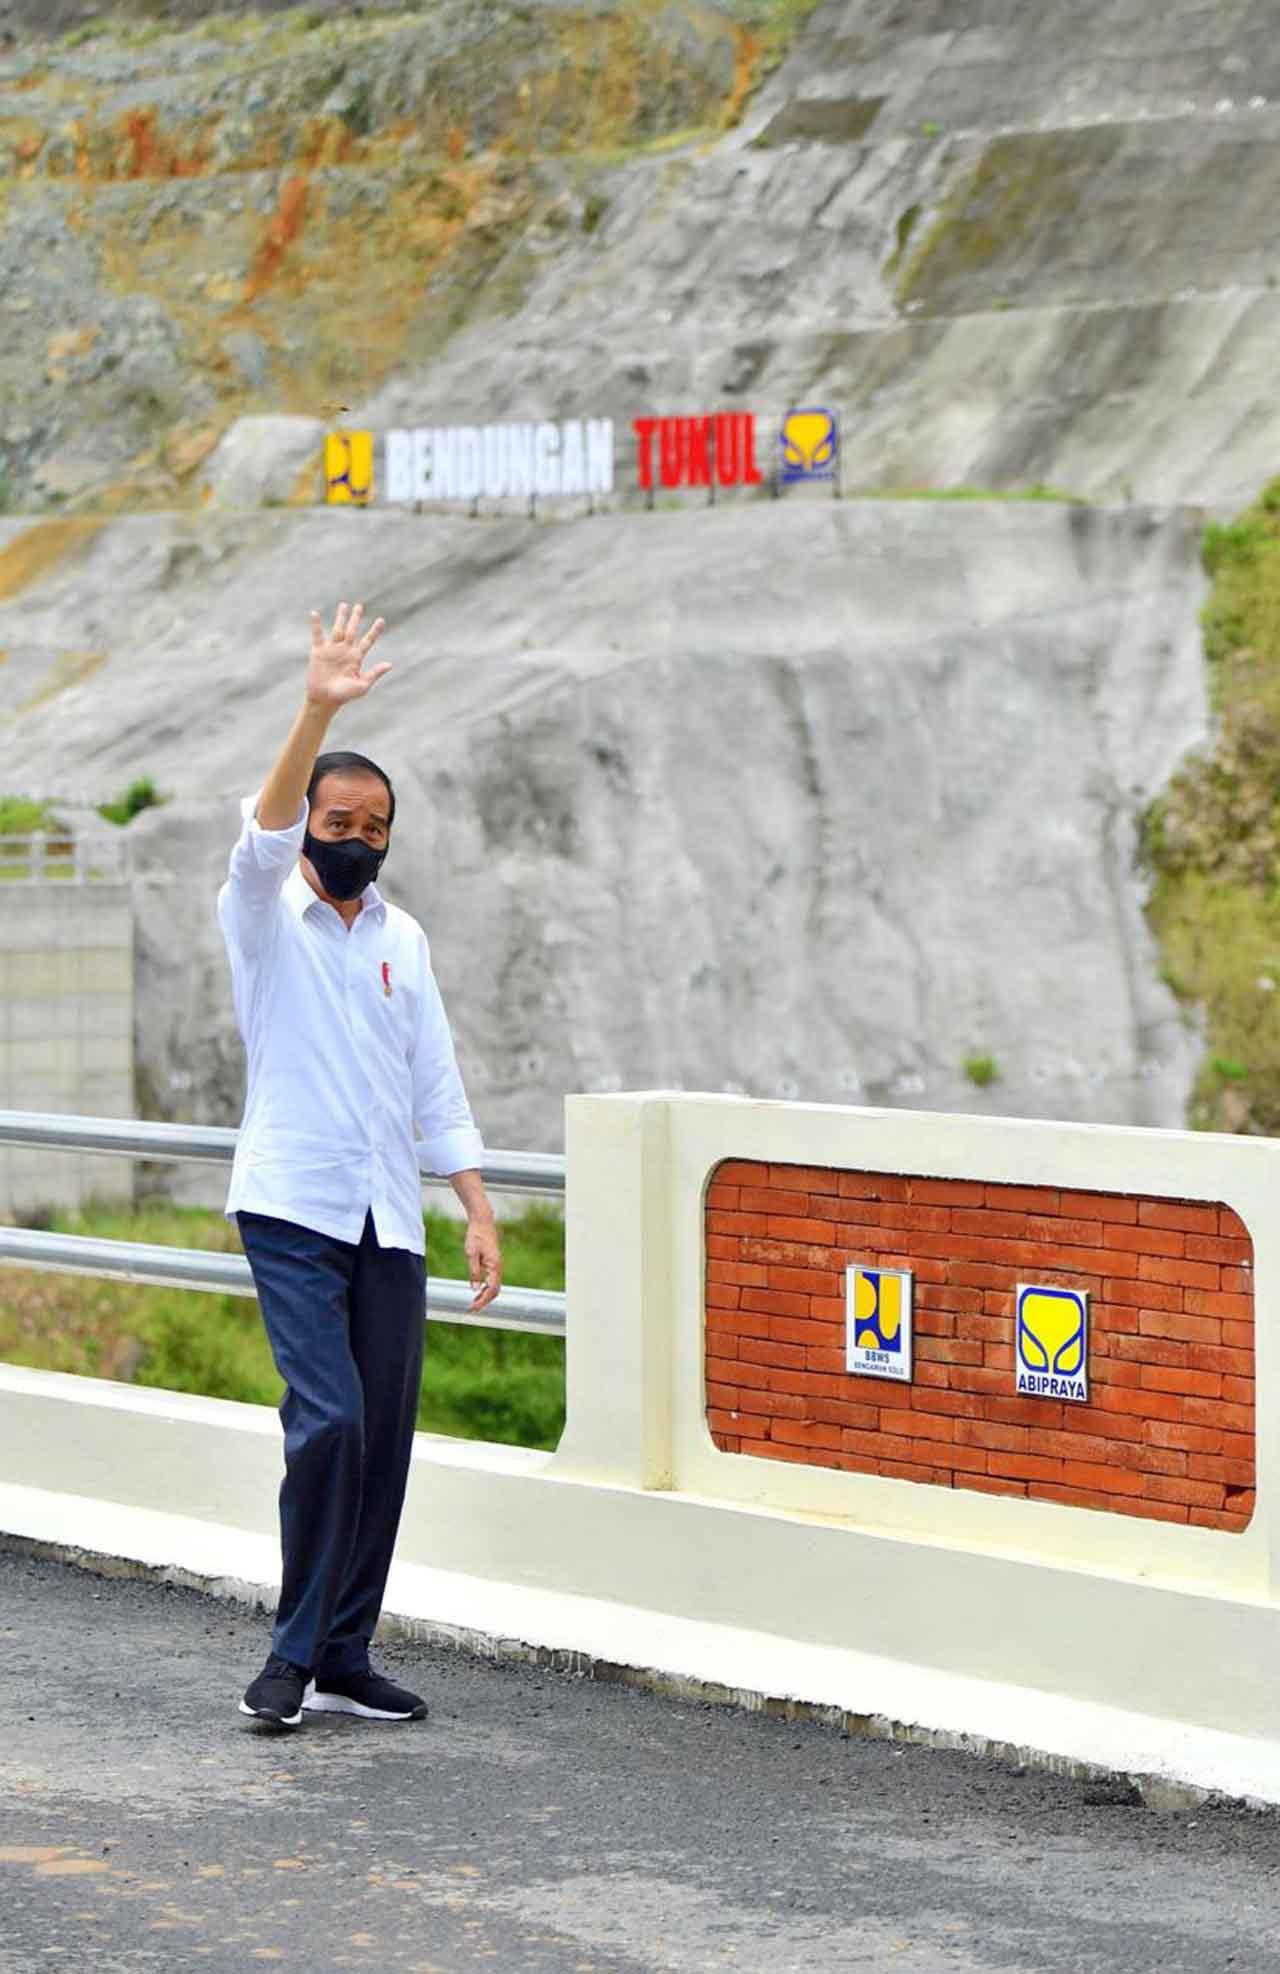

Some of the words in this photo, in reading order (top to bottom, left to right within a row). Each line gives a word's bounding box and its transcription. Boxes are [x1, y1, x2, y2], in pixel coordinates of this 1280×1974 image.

[385, 417, 614, 501] BENDUNGAN
[633, 411, 762, 490] TUKUL
[1018, 1374, 1085, 1399] ABIPRAYA
